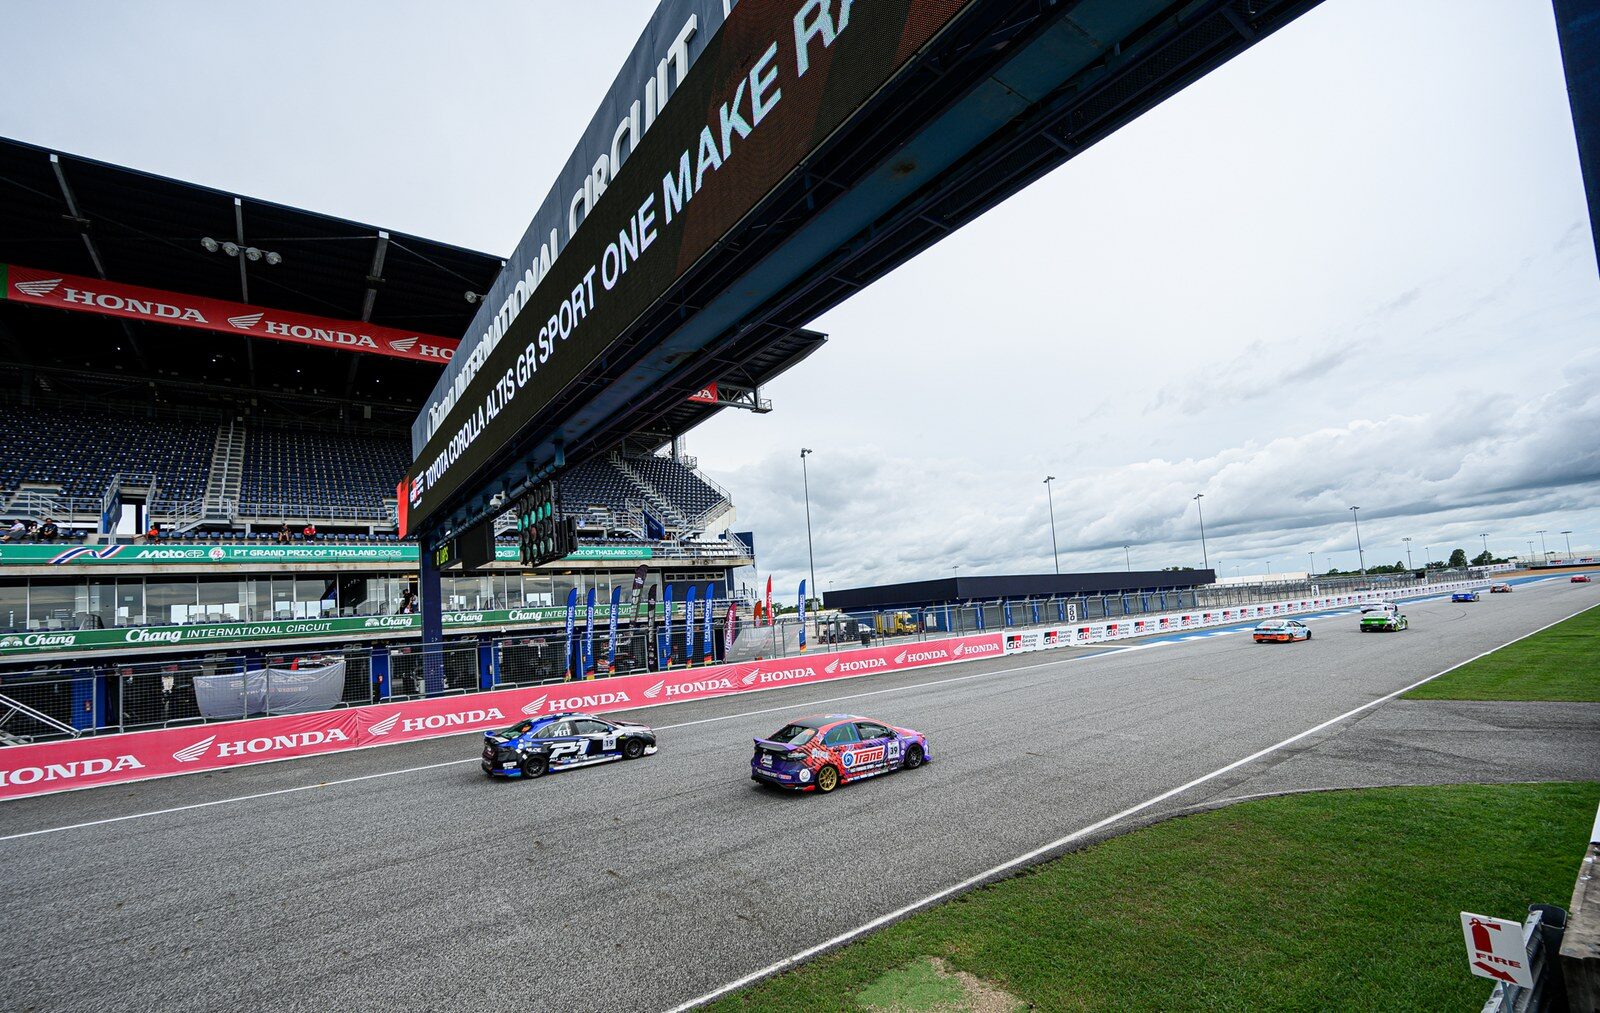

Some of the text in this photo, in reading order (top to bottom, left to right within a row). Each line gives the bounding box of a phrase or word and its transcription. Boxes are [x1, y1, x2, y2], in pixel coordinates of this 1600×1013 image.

[426, 449, 449, 490] TOYOTA
[448, 406, 485, 465] COROLLA
[486, 368, 515, 424] ALTIS
[516, 342, 537, 388] GR
[538, 265, 596, 364] SPORT
[601, 192, 658, 291] ONE
[663, 41, 782, 226] MAKE
[64, 288, 208, 324] HONDA
[265, 321, 378, 349] HONDA
[380, 616, 413, 626] Chang
[454, 613, 483, 622] Chang
[508, 609, 542, 621] Chang
[24, 634, 76, 646] Chang
[126, 622, 332, 643] Chang INTERNATIONAL CIRCUIT
[1044, 637, 1056, 645] GR
[1077, 632, 1089, 640] GR
[963, 643, 999, 655] HONDA
[1007, 641, 1020, 649] GR
[840, 657, 887, 672] HONDA
[908, 649, 948, 663] HONDA
[760, 667, 816, 684] HONDA
[665, 678, 732, 697] HONDA
[548, 691, 630, 712] HONDA
[402, 707, 505, 733] HONDA
[217, 728, 348, 758] HONDA
[853, 746, 883, 764] Trane
[1475, 952, 1521, 969] FIRE
